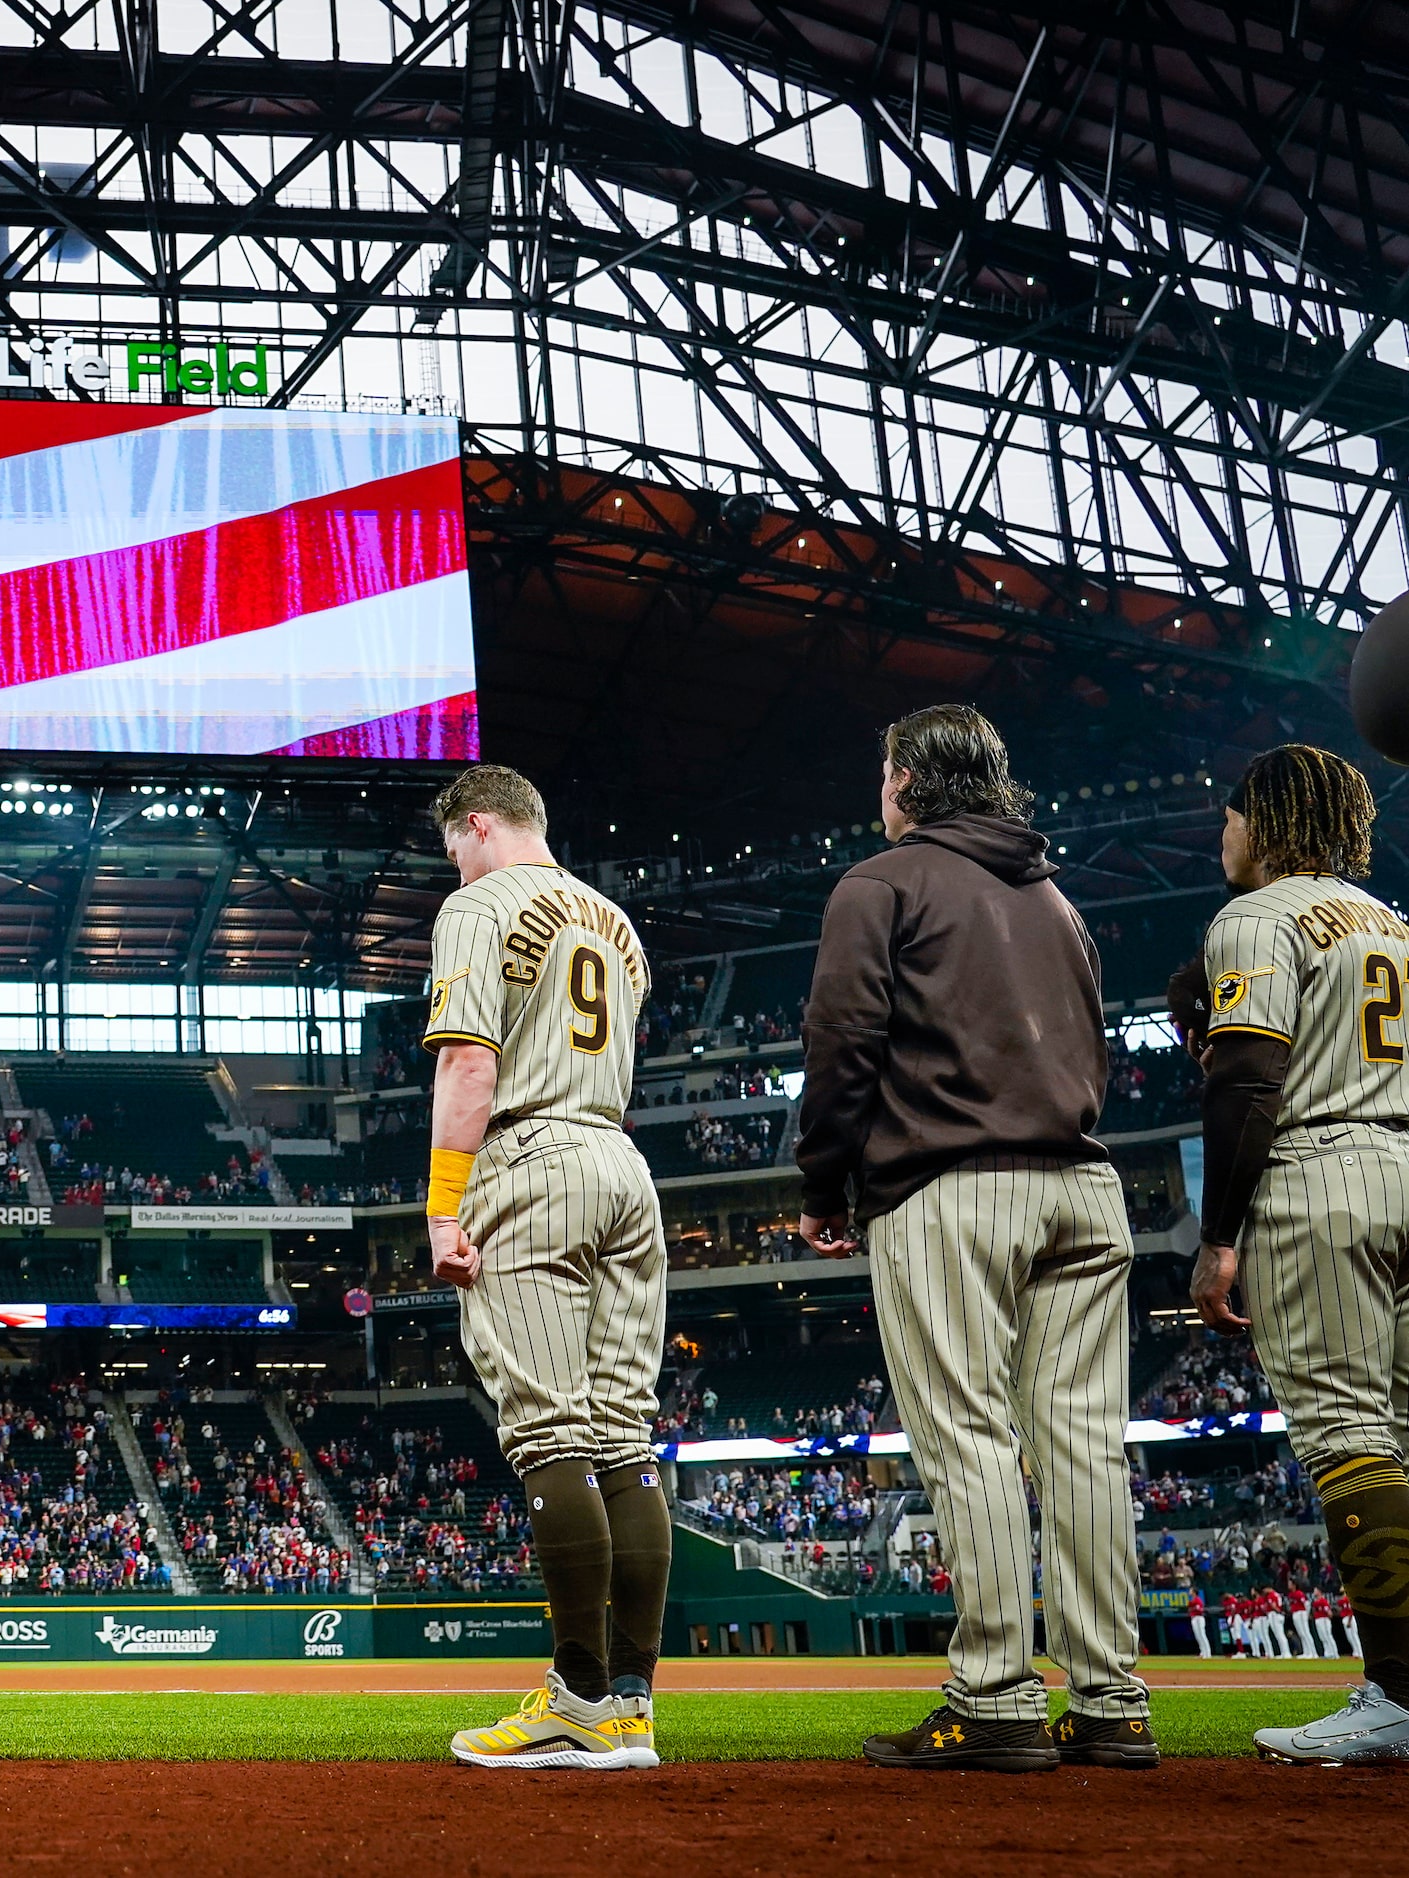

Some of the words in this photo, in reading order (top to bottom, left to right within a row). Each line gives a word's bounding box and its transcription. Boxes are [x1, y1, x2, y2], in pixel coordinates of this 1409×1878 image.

[126, 341, 269, 397] Field
[568, 943, 610, 1056] 9
[1360, 951, 1409, 1066] 2
[138, 1212, 153, 1222] The
[155, 1212, 180, 1221] Dallas
[182, 1212, 216, 1222] Morning
[217, 1212, 239, 1221] News
[248, 1214, 268, 1222] Real
[271, 1213, 292, 1222] local
[295, 1214, 347, 1223] Journalism.
[375, 1297, 409, 1308] DALLAS
[410, 1293, 445, 1305] TRUCK
[258, 1309, 290, 1324] 6:56
[131, 1625, 217, 1643] Germania
[474, 1629, 497, 1638] Texas
[137, 1644, 200, 1652] INSURANCE
[304, 1643, 344, 1657] SPORTS
